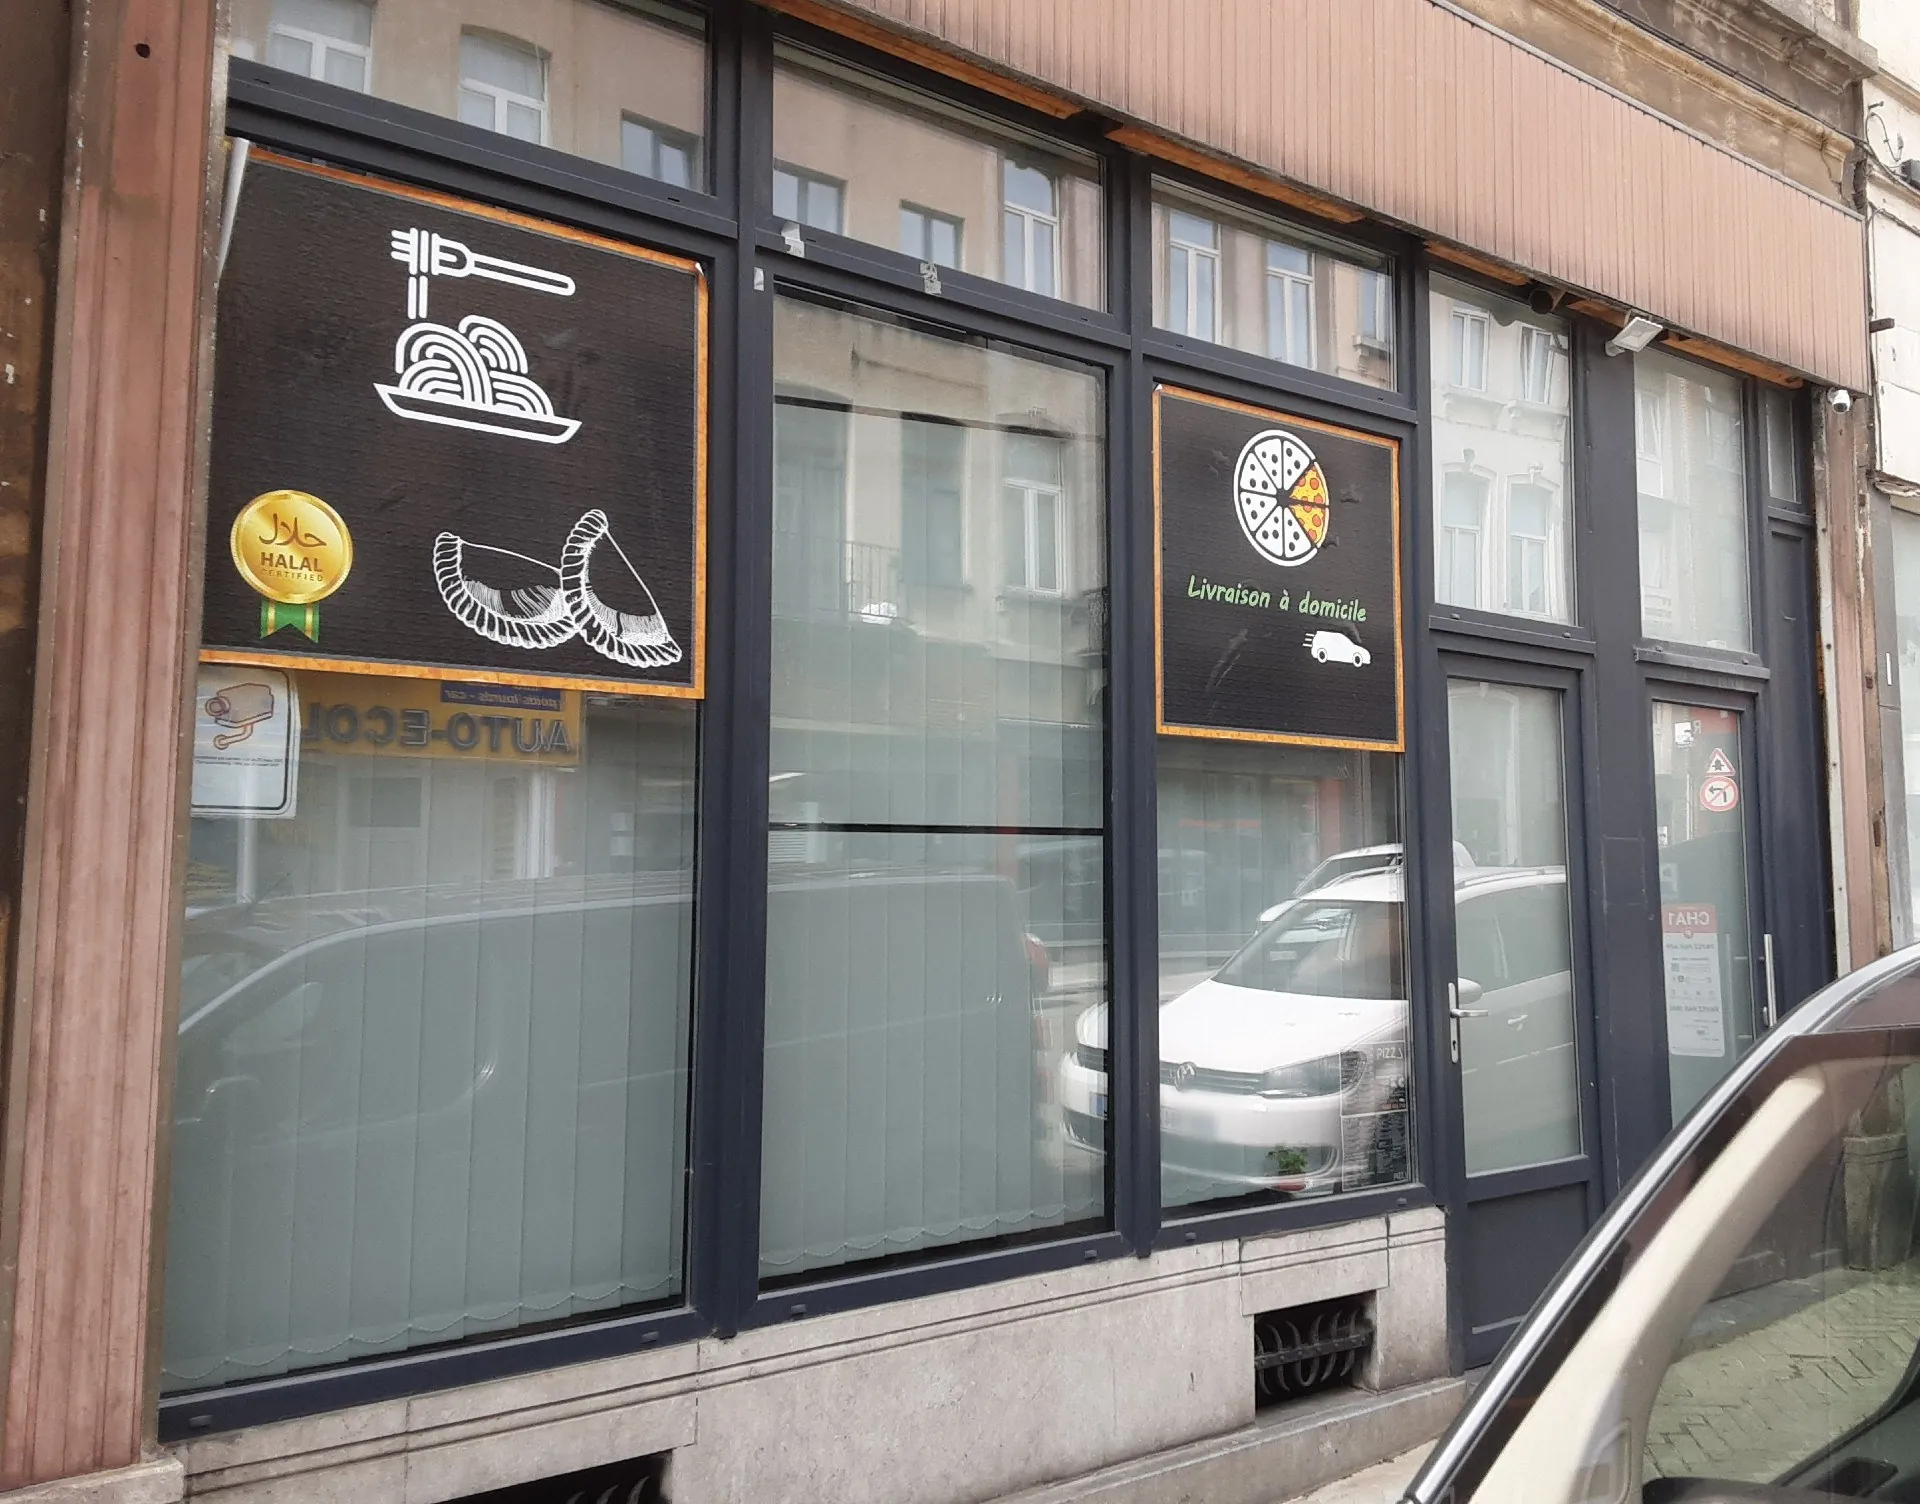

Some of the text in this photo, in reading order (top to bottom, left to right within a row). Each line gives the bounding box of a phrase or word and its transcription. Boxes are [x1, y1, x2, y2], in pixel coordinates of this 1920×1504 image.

[259, 513, 327, 547] حلال
[261, 551, 324, 572] HALAL
[261, 568, 324, 582] CERTIFIED
[1187, 575, 1367, 622] Livraison à domicile
